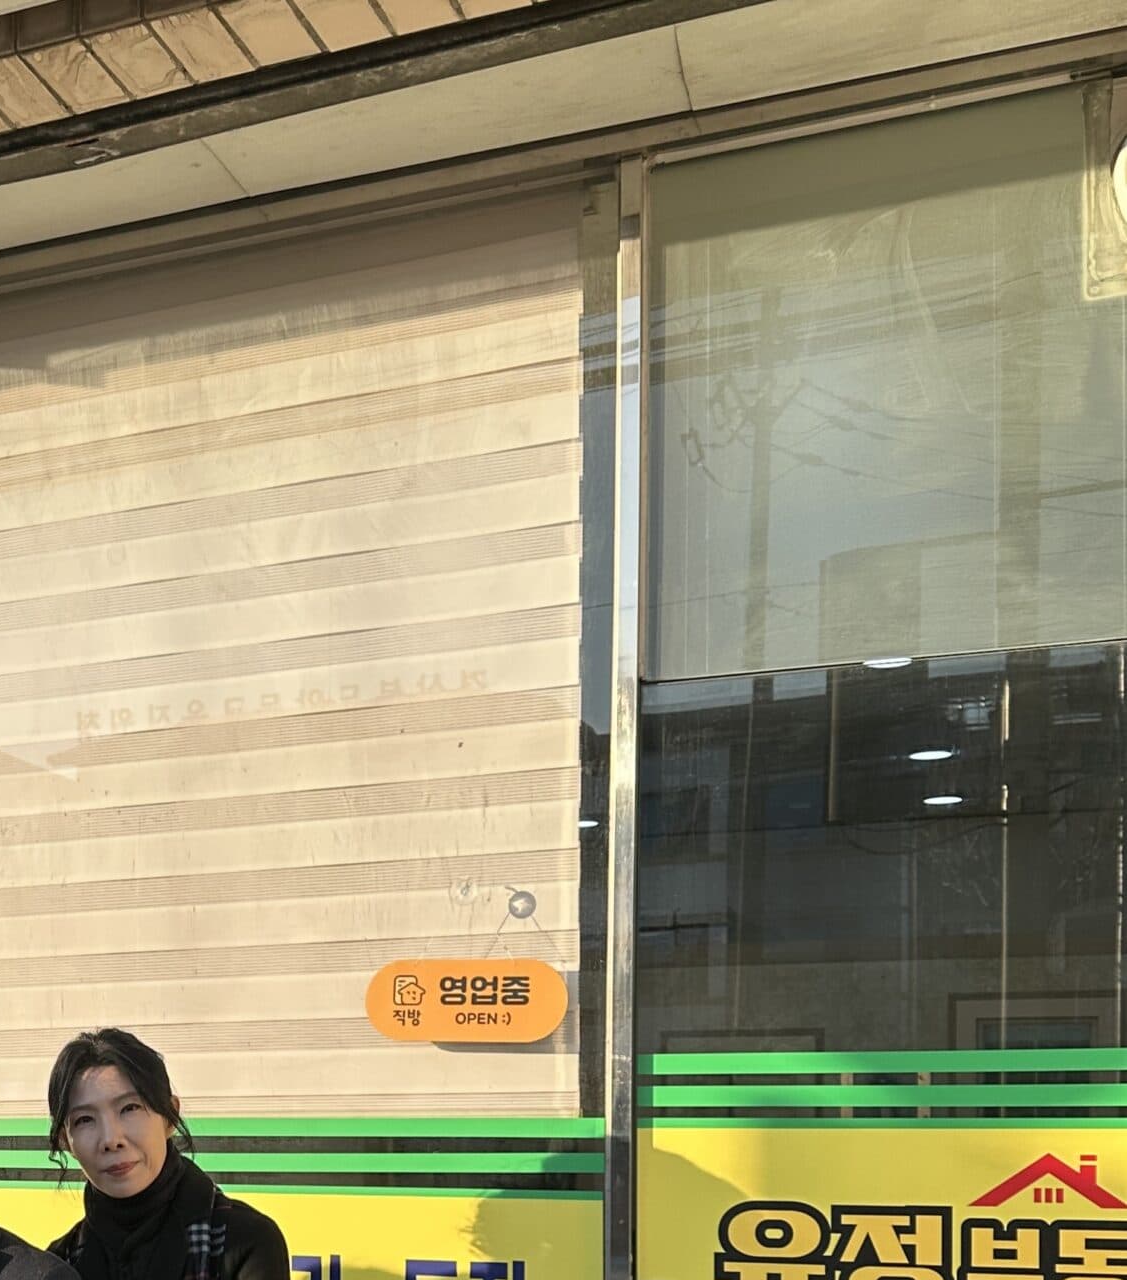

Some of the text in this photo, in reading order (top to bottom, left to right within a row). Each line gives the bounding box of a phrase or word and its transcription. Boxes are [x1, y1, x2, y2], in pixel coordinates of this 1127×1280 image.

[439, 975, 531, 1006] 영업중
[393, 1009, 422, 1027] 직방
[455, 1012, 498, 1025] OPEN
